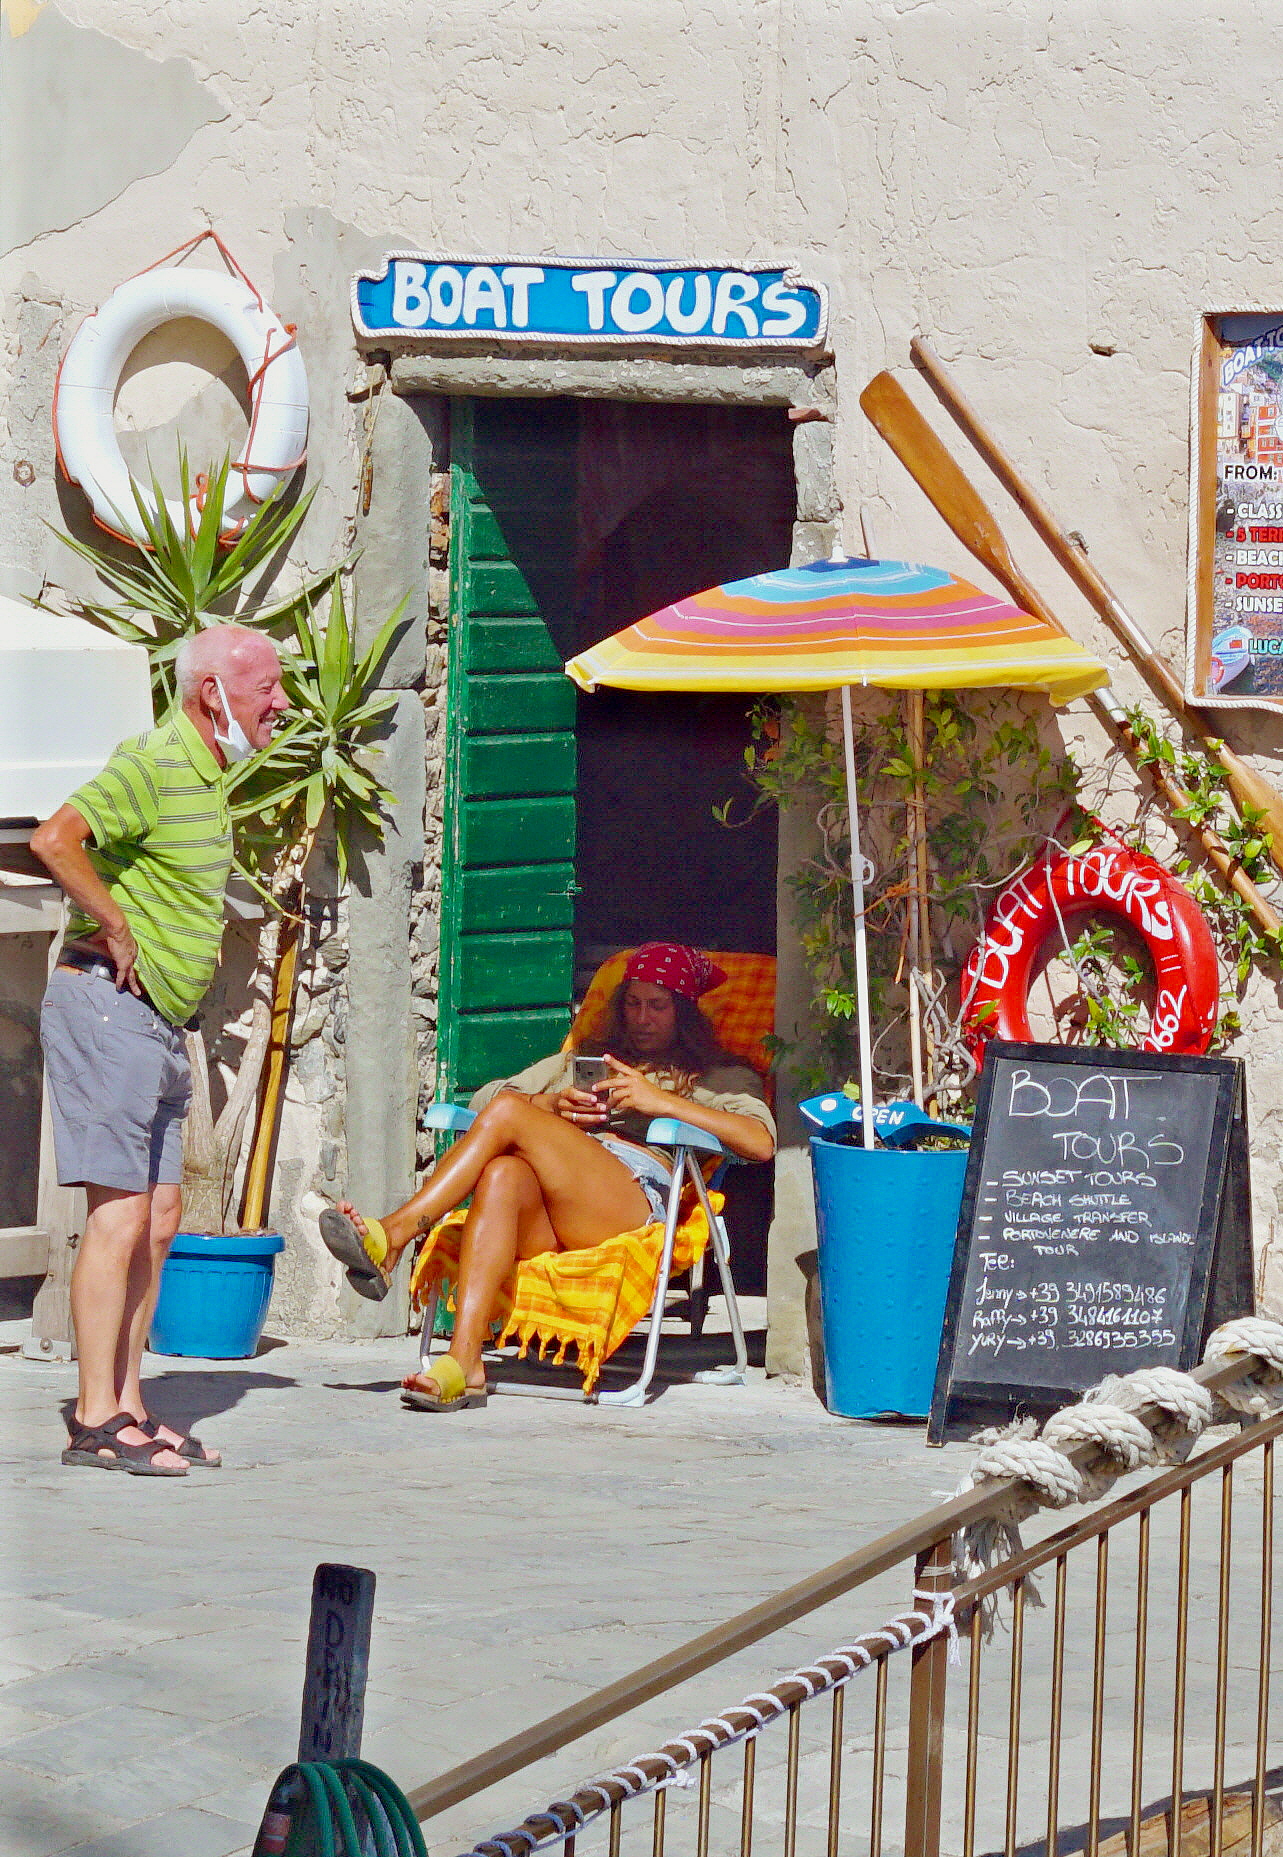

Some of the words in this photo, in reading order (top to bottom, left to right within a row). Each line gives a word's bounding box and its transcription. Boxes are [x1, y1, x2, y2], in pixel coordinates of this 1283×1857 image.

[393, 261, 544, 328] BOAT
[571, 271, 807, 337] TOURS
[1223, 335, 1263, 386] BOAT
[1224, 464, 1278, 480] FROM:
[1236, 526, 1247, 542] 5
[967, 866, 1044, 989] BOAT
[1060, 853, 1175, 940] TOURS
[1009, 1069, 1162, 1120] BOAT
[1053, 1131, 1184, 1169] TOURS
[1002, 1170, 1083, 1187] SUNSET
[1084, 1170, 1157, 1187] TOURS
[1006, 1189, 1062, 1208] BEACH
[1069, 1193, 1132, 1206] SHUTTLE
[1004, 1210, 1064, 1224] VILLAGE
[1073, 1210, 1152, 1228] TRANSFER
[1032, 1244, 1080, 1257] TOUR
[1029, 1282, 1060, 1303] +39
[1029, 1305, 1059, 1328] +39
